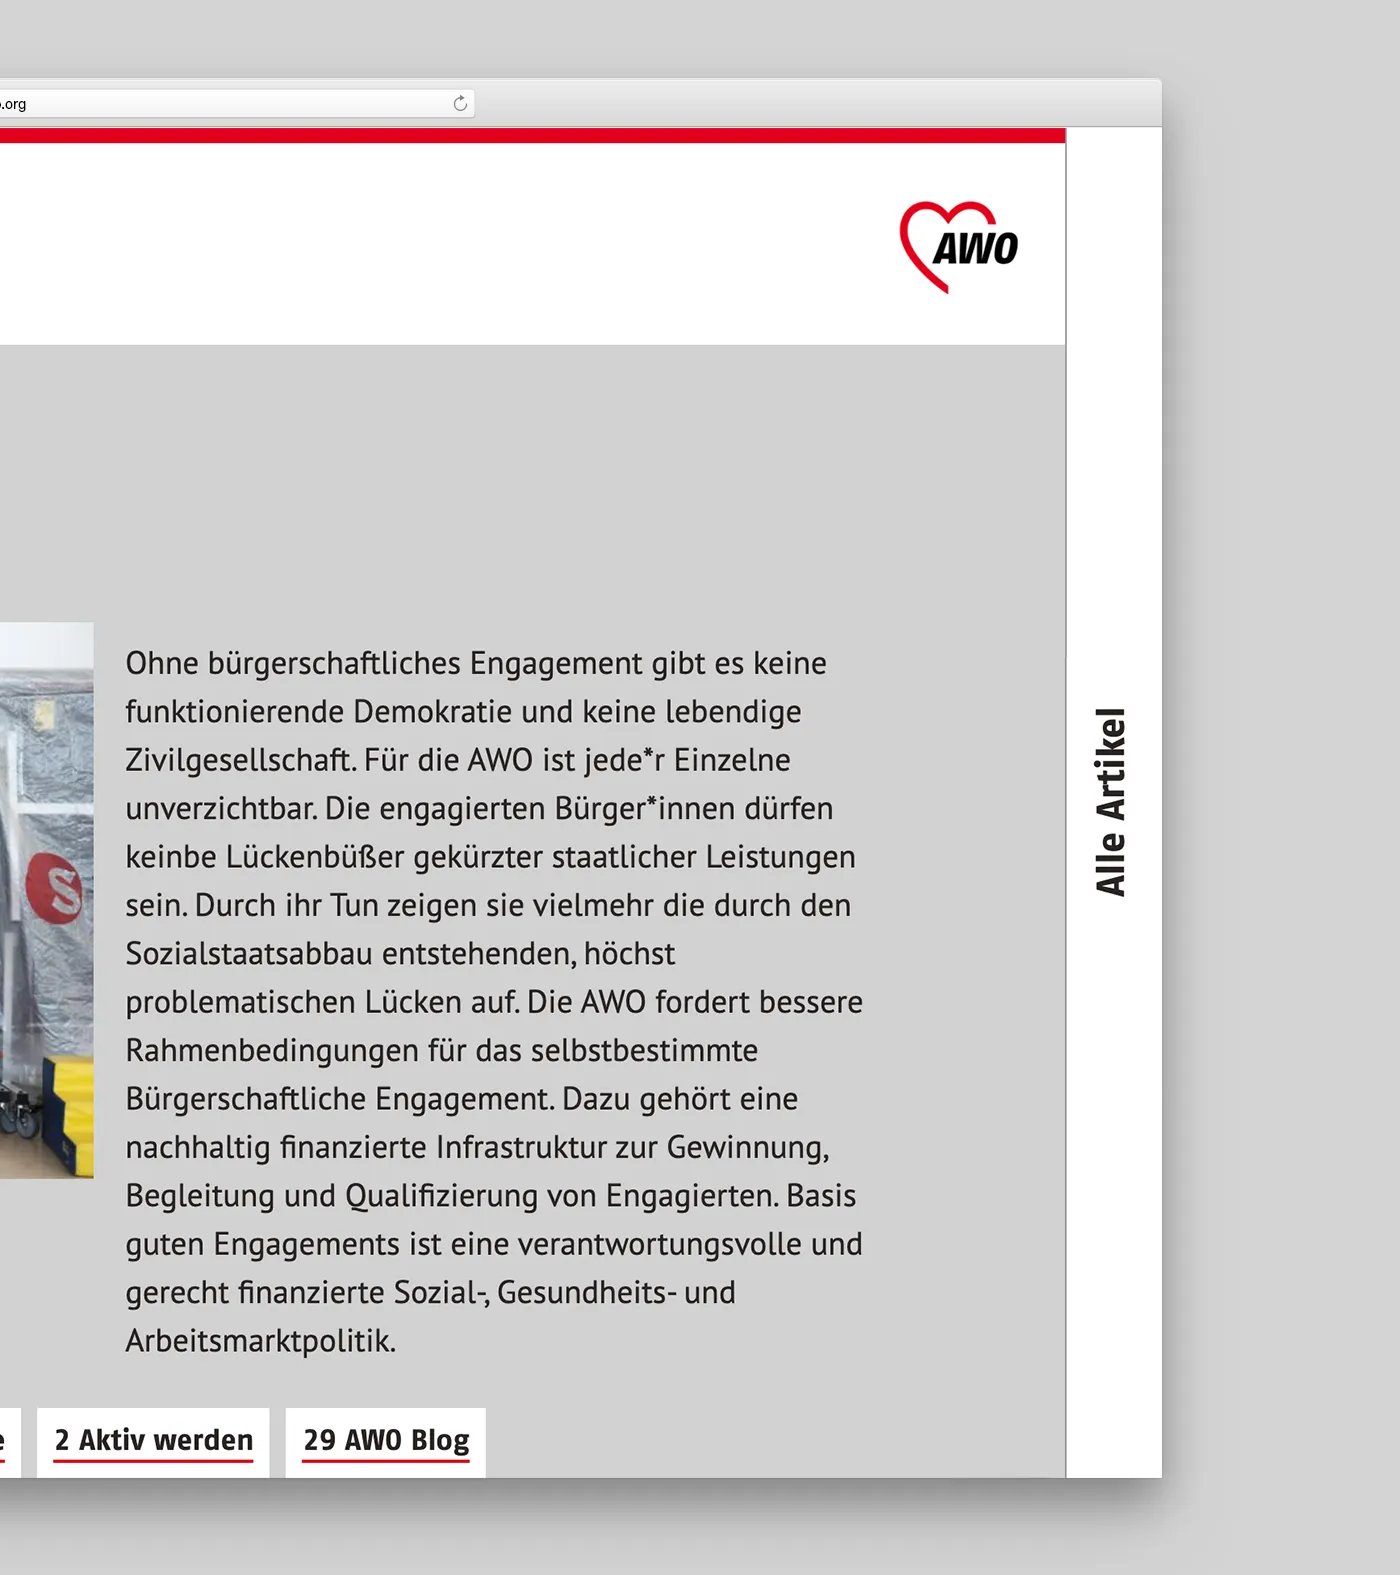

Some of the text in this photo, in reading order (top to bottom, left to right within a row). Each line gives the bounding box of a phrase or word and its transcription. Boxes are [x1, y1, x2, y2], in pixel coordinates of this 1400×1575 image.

[932, 232, 1018, 264] AWO
[127, 650, 826, 681] Ohne bürgerschaftliches Engagement gibt es keine
[125, 699, 801, 730] funktionierende Demokratie und keine lebendige
[126, 747, 357, 778] Zivilgesellschaft.
[366, 747, 409, 771] Für
[419, 747, 459, 771] die
[467, 747, 532, 771] AWO
[544, 747, 575, 771] ist
[676, 747, 790, 771] Einzelne
[127, 796, 317, 820] unverzichtbar.
[327, 796, 370, 820] Die
[380, 796, 544, 826] engagierten
[745, 796, 832, 820] dürfen
[1093, 709, 1125, 897] Alle Artikel
[127, 844, 855, 875] keinbe Lückenbüßer gekürzter staatlicher Leistungen
[126, 892, 850, 923] sein. Durch ihr Tun zeigen sie vielmehr die durch den
[126, 941, 676, 969] Sozialstaatsabbau entstehenden, höchst
[127, 989, 862, 1020] problematischen Lücken auf. Die AWO fordert bessere
[128, 1038, 757, 1068] Rahmenbedingungen für das selbstbestimmte
[128, 1086, 797, 1117] Bürgerschaftliche Engagement. Dazu gehört eine
[127, 1134, 829, 1165] nachhaltig finanzierte Infrastruktur zur Gewinnung,
[127, 1183, 856, 1214] Begleitung und Qualifizierung von Engagierten. Basis
[126, 1231, 861, 1262] guten Engagements ist eine verantwortungsvolle und
[126, 1280, 735, 1310] gerecht finanzierte Sozial-, Gesundheits- und
[125, 1328, 395, 1358] Arbeitsmarktpolitik.
[56, 1427, 252, 1450] 2 Aktiv werden
[305, 1429, 469, 1456] 29 AWO Blog
